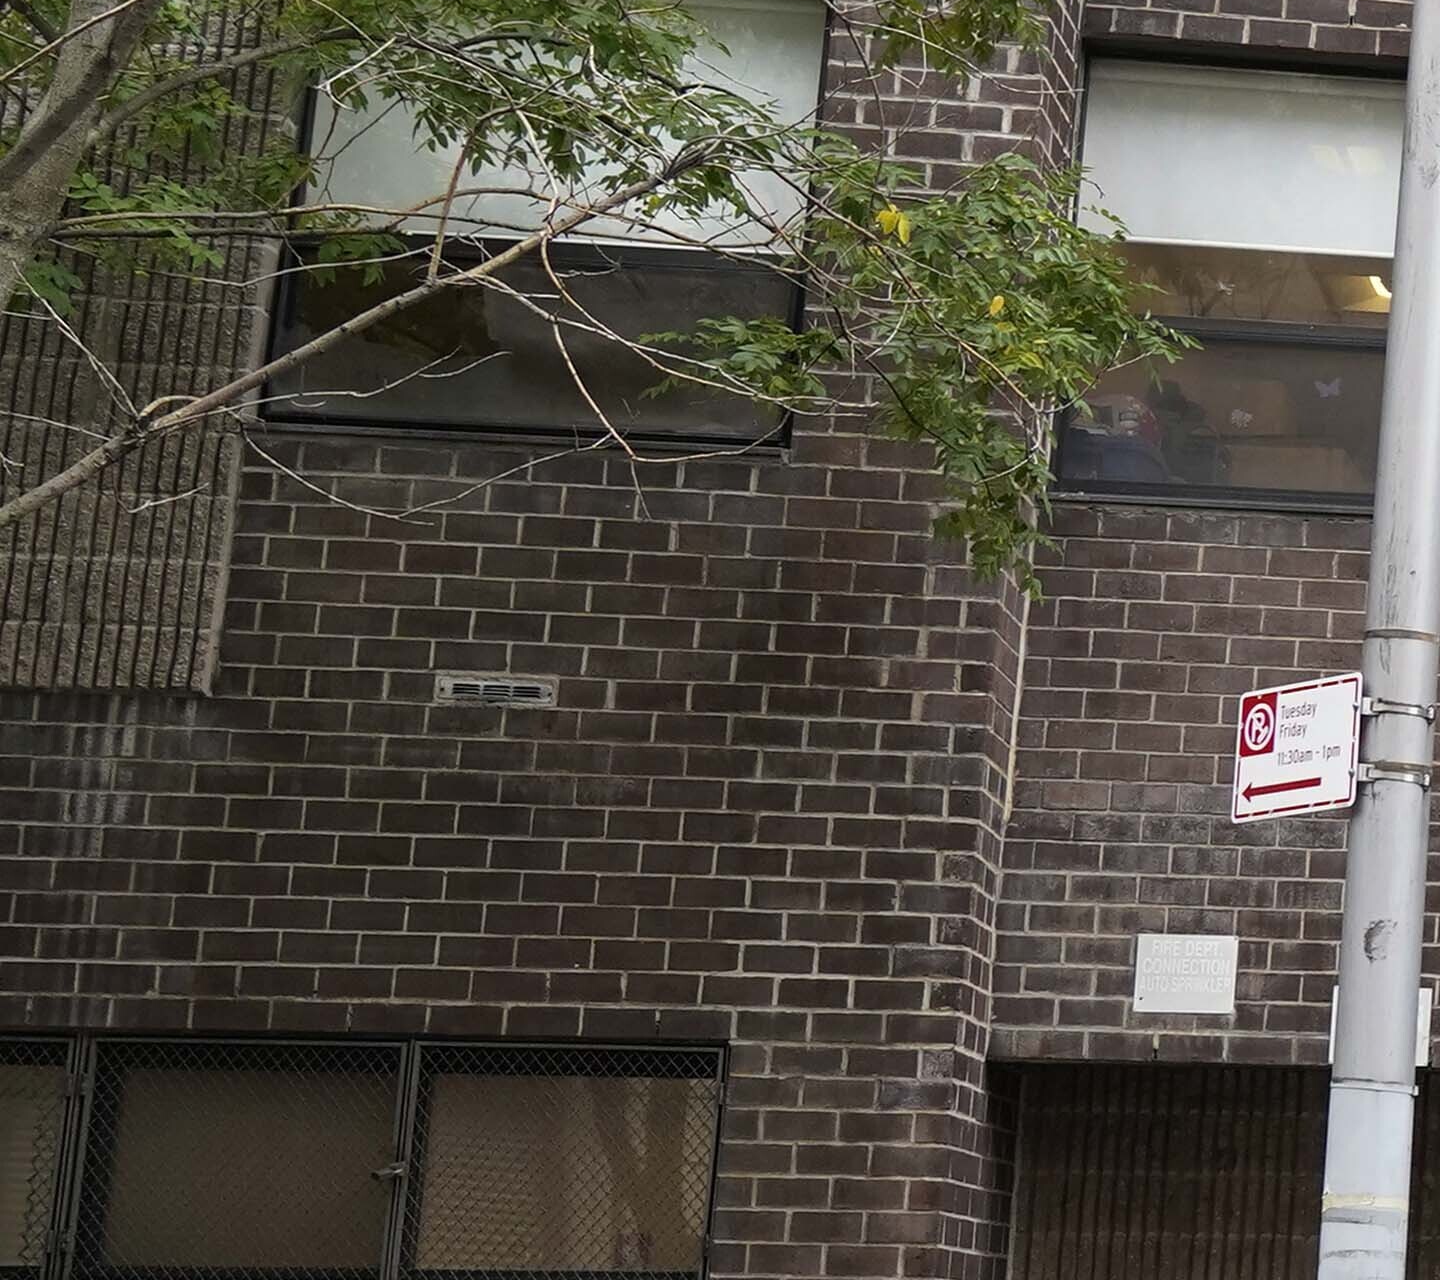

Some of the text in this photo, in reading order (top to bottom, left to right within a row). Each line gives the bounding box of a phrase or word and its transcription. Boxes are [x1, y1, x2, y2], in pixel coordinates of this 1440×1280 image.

[1281, 702, 1318, 720] Tuesday
[1279, 724, 1308, 739] Friday
[1277, 748, 1313, 766] 11:30am
[1322, 745, 1341, 761] 1pm
[1143, 958, 1231, 974] CONNECTION
